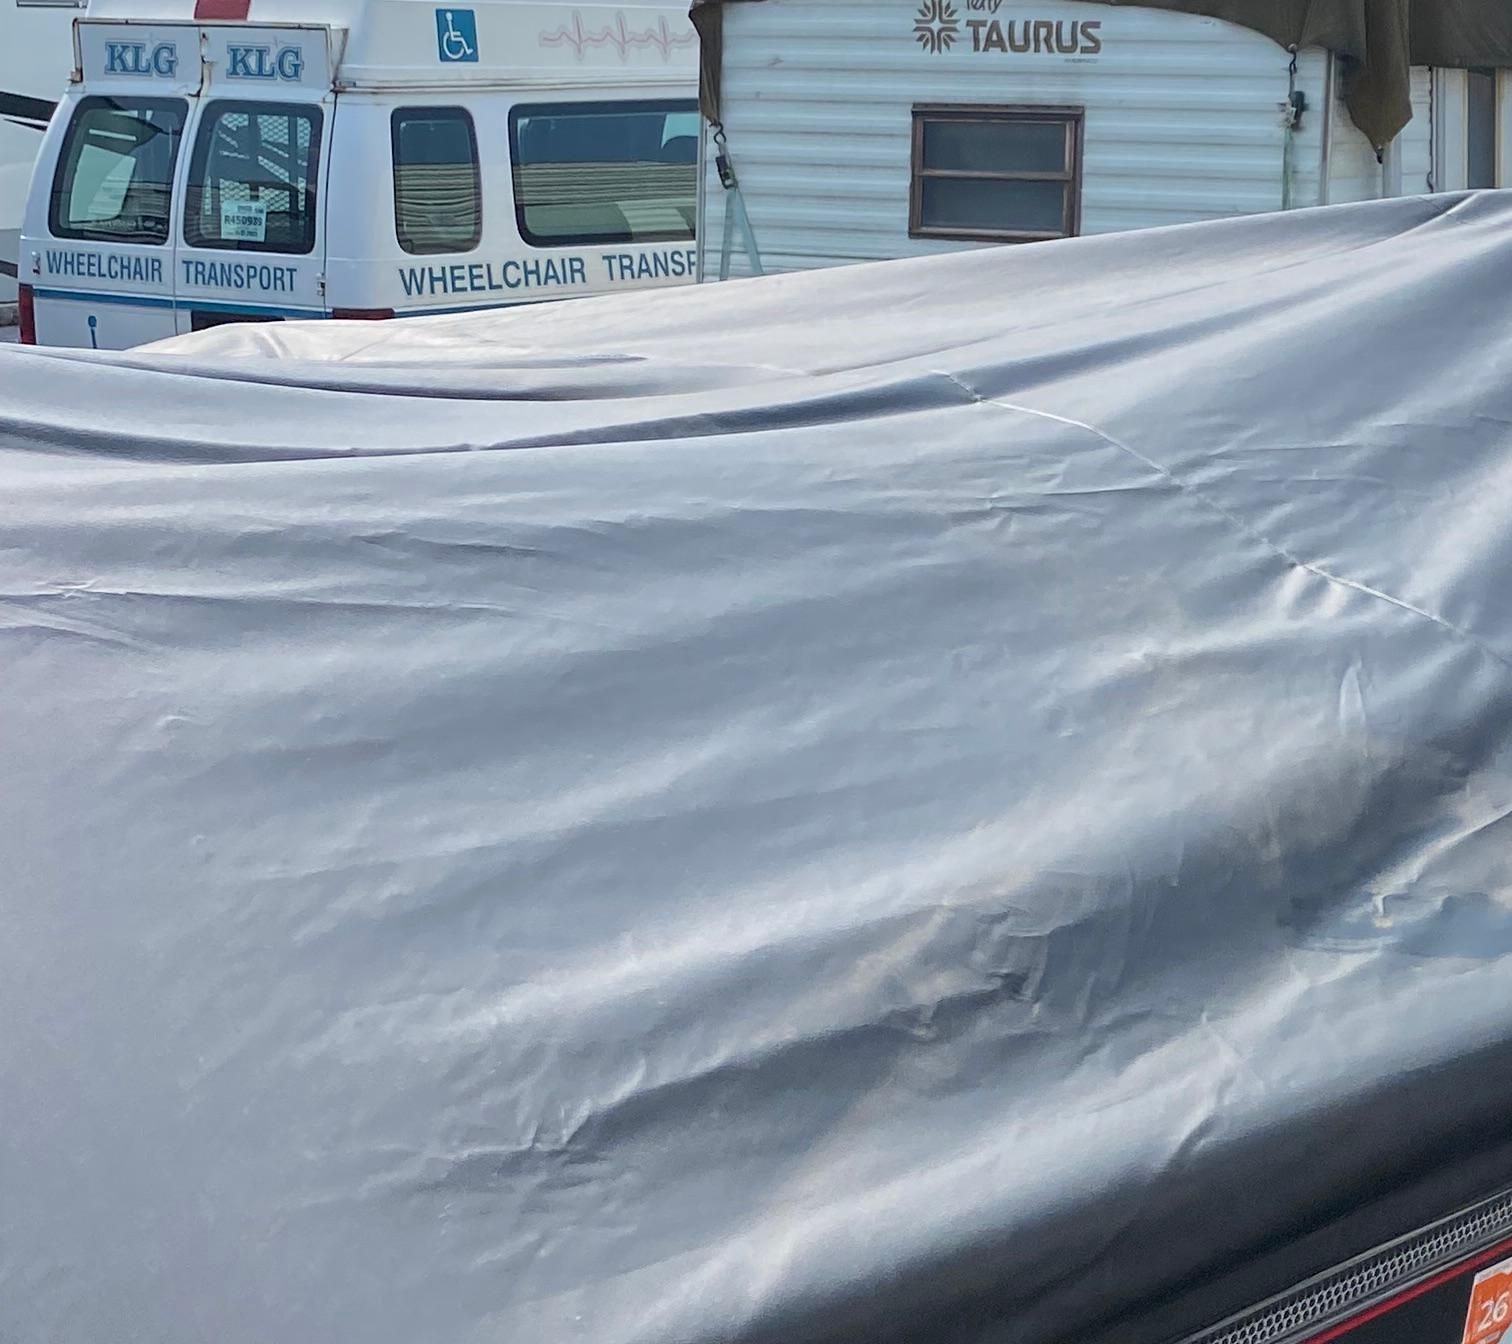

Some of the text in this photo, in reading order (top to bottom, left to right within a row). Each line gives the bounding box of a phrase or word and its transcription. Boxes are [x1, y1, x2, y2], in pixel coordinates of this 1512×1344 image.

[965, 19, 1102, 55] TAURUS
[104, 40, 178, 78] KLG
[226, 44, 304, 82] KLG
[46, 250, 298, 292] WHEELCHAIR TRANSPORT
[398, 256, 587, 296] WHEELCHAIR
[1476, 1291, 1512, 1334] 26
